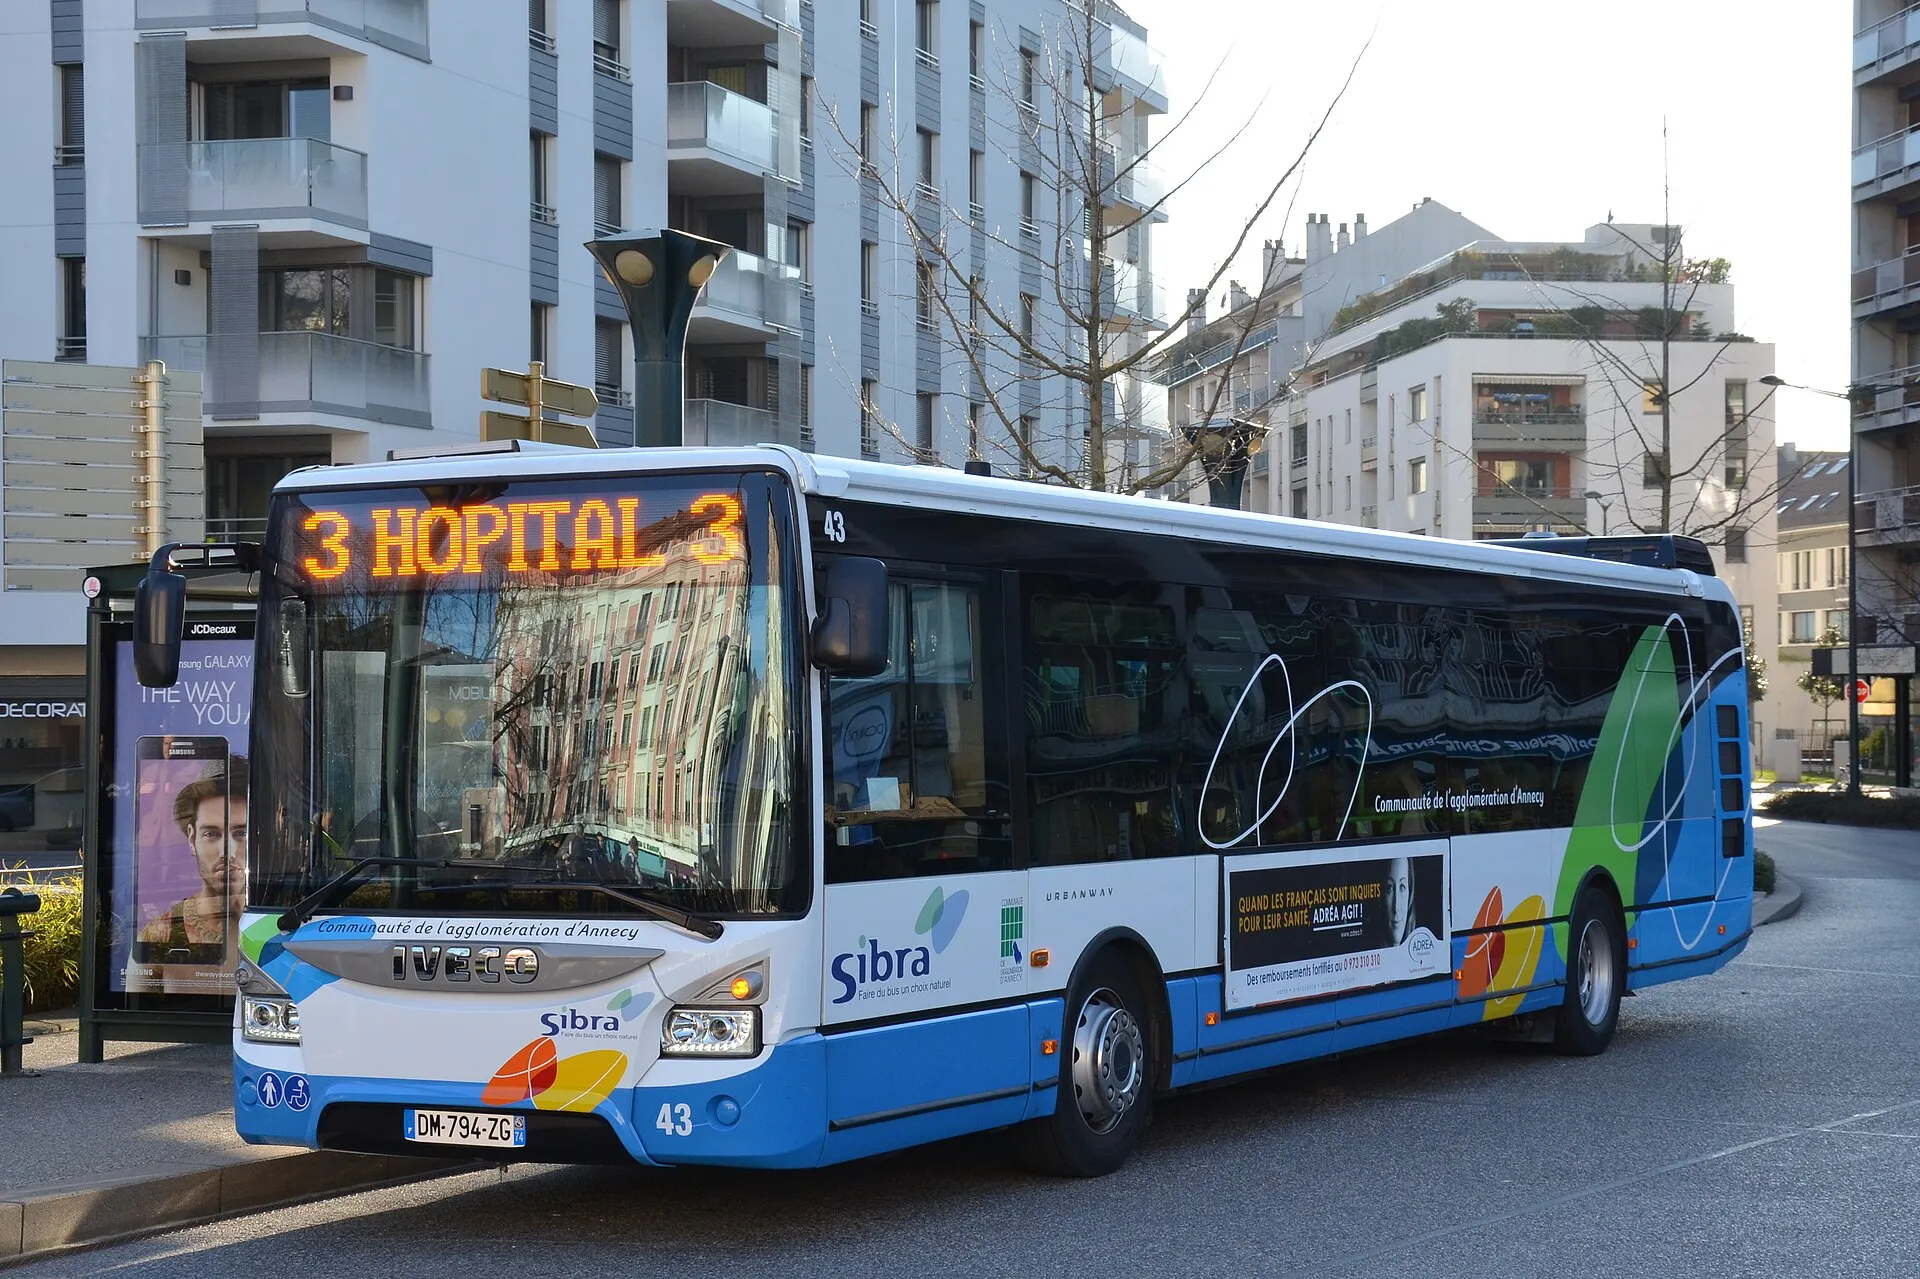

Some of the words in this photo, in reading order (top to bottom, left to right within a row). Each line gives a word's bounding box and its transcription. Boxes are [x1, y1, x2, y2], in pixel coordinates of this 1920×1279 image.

[304, 511, 350, 579] 3
[371, 498, 666, 577] HOPITAL
[690, 494, 739, 565] 3
[824, 510, 846, 543] 43
[190, 624, 237, 634] JCDecaux
[204, 655, 252, 668] GALAXY
[137, 681, 181, 703] THE
[184, 680, 236, 703] WAY
[192, 703, 241, 725] YOU
[1375, 791, 1431, 813] Communauté
[1433, 791, 1444, 809] de
[1445, 787, 1509, 813] l'agglomération
[1510, 784, 1545, 808] d'Annecy
[1238, 895, 1269, 914] QUAND
[1271, 893, 1284, 909] LES
[1286, 889, 1327, 909] FRANÇAIS
[1328, 887, 1348, 903] SONT
[1349, 883, 1381, 900] INQUIETS
[318, 920, 412, 934] Communauté
[414, 921, 433, 934] de
[437, 920, 559, 939] l'agglomération
[564, 921, 640, 941] d'Annecy
[1238, 916, 1261, 933] POUR
[1263, 913, 1282, 930] LEUR
[1283, 908, 1311, 928] SANTÉ,
[1312, 904, 1340, 924] ADRÉA
[1341, 903, 1359, 920] AGIT
[391, 945, 540, 985] IVECO
[831, 935, 930, 1004] Sibra
[1246, 973, 1259, 986] Des
[1259, 964, 1312, 984] remboursements
[1334, 963, 1342, 972] au
[1343, 958, 1348, 971] 0
[1349, 957, 1359, 969] 973
[1360, 955, 1370, 968] 310
[1370, 954, 1381, 966] 310
[858, 989, 876, 1001] Faire
[876, 988, 886, 998] du
[887, 987, 900, 996] bus
[901, 986, 910, 995] un
[910, 983, 928, 993] choix
[929, 978, 952, 990] naturel
[540, 1005, 619, 1036] Sibra
[417, 1113, 511, 1141] DM-794-ZG
[514, 1131, 524, 1142] 74
[656, 1103, 693, 1136] 43
